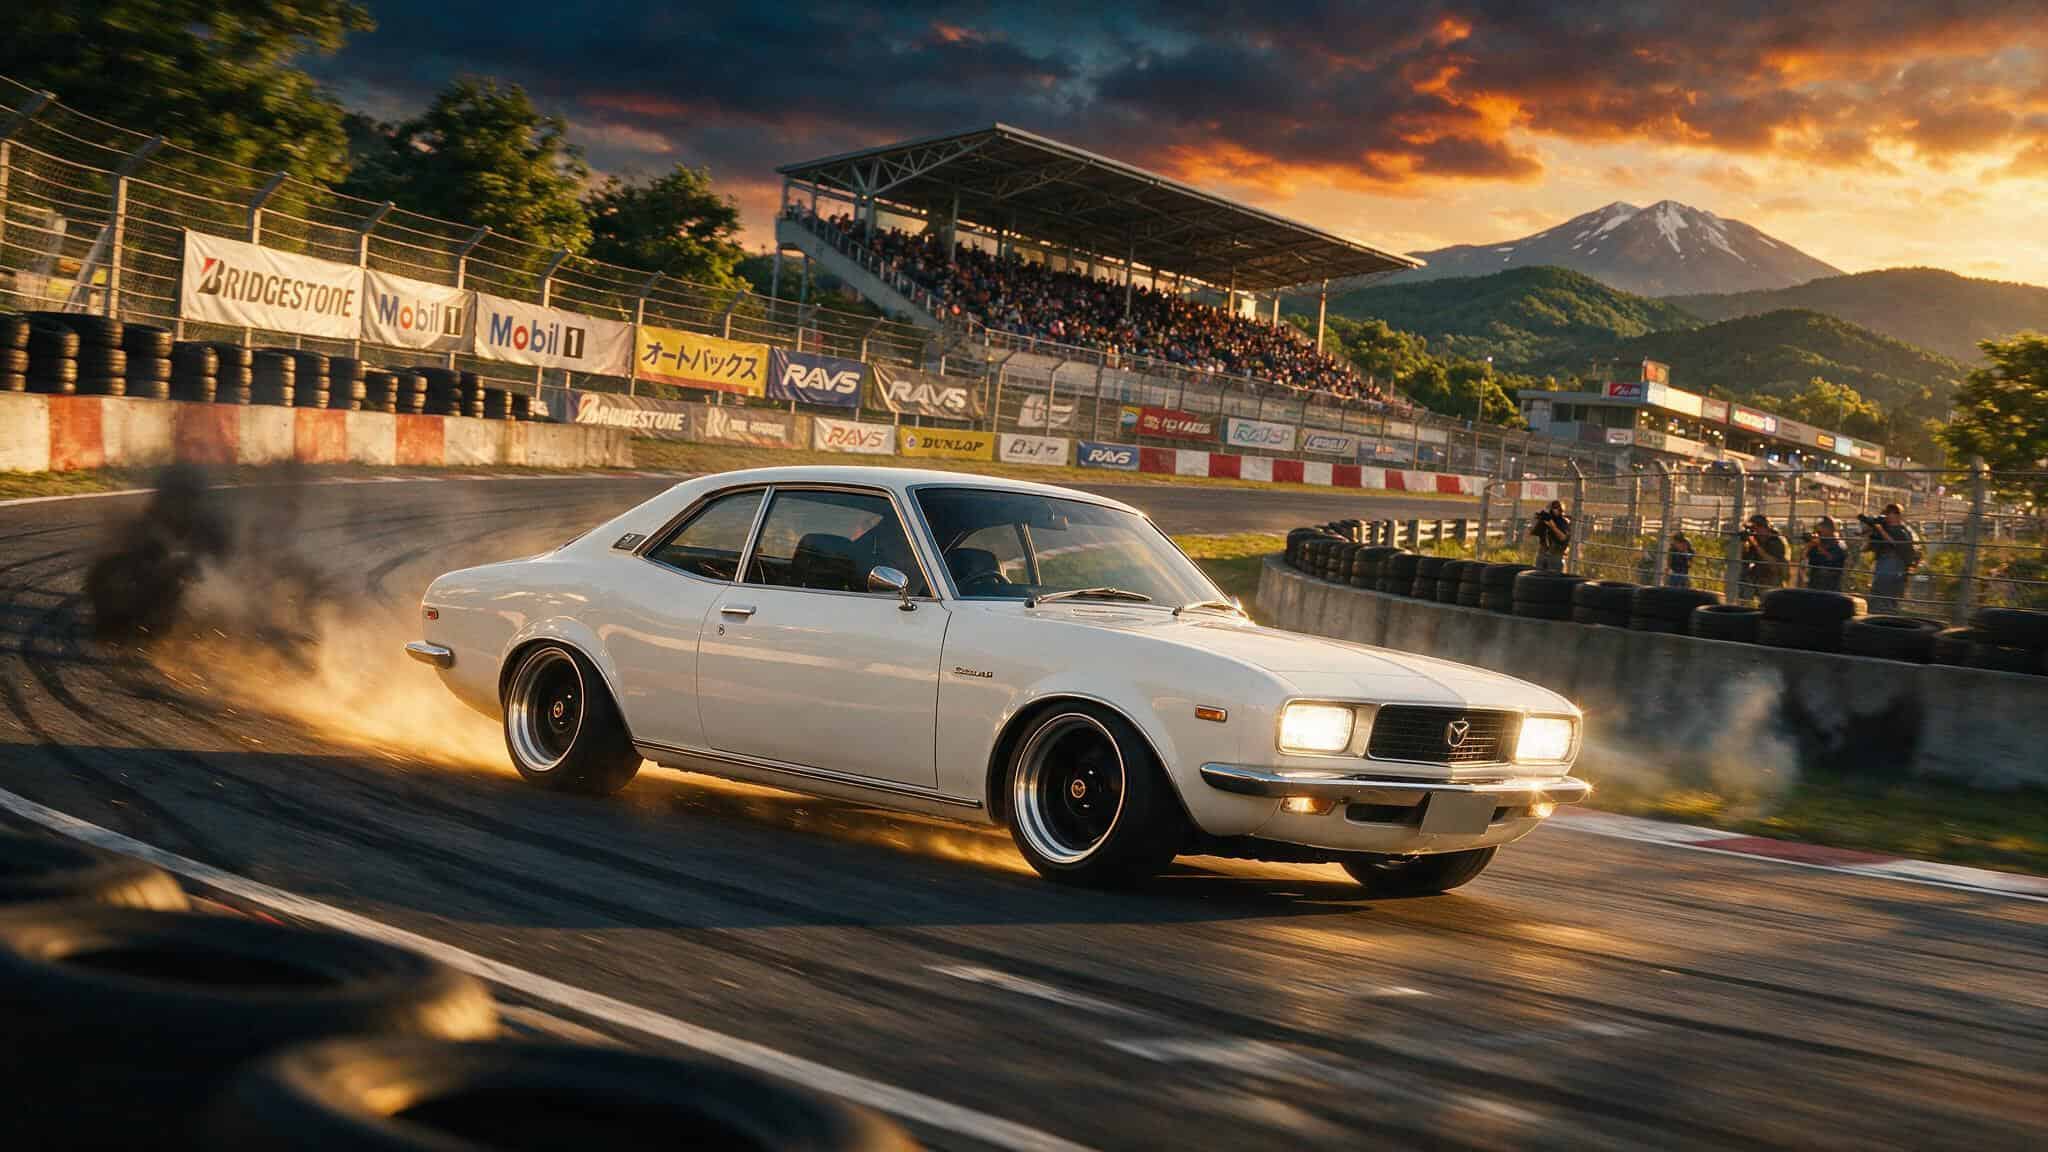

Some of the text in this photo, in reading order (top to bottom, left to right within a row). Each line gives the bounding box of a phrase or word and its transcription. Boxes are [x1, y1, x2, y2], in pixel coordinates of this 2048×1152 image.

[198, 256, 355, 317] BRIDGESTONE
[379, 293, 459, 335] Mobil 1
[489, 312, 582, 358] Mobil 1
[642, 341, 758, 381] オートバックス
[922, 436, 985, 451] DUNLOP
